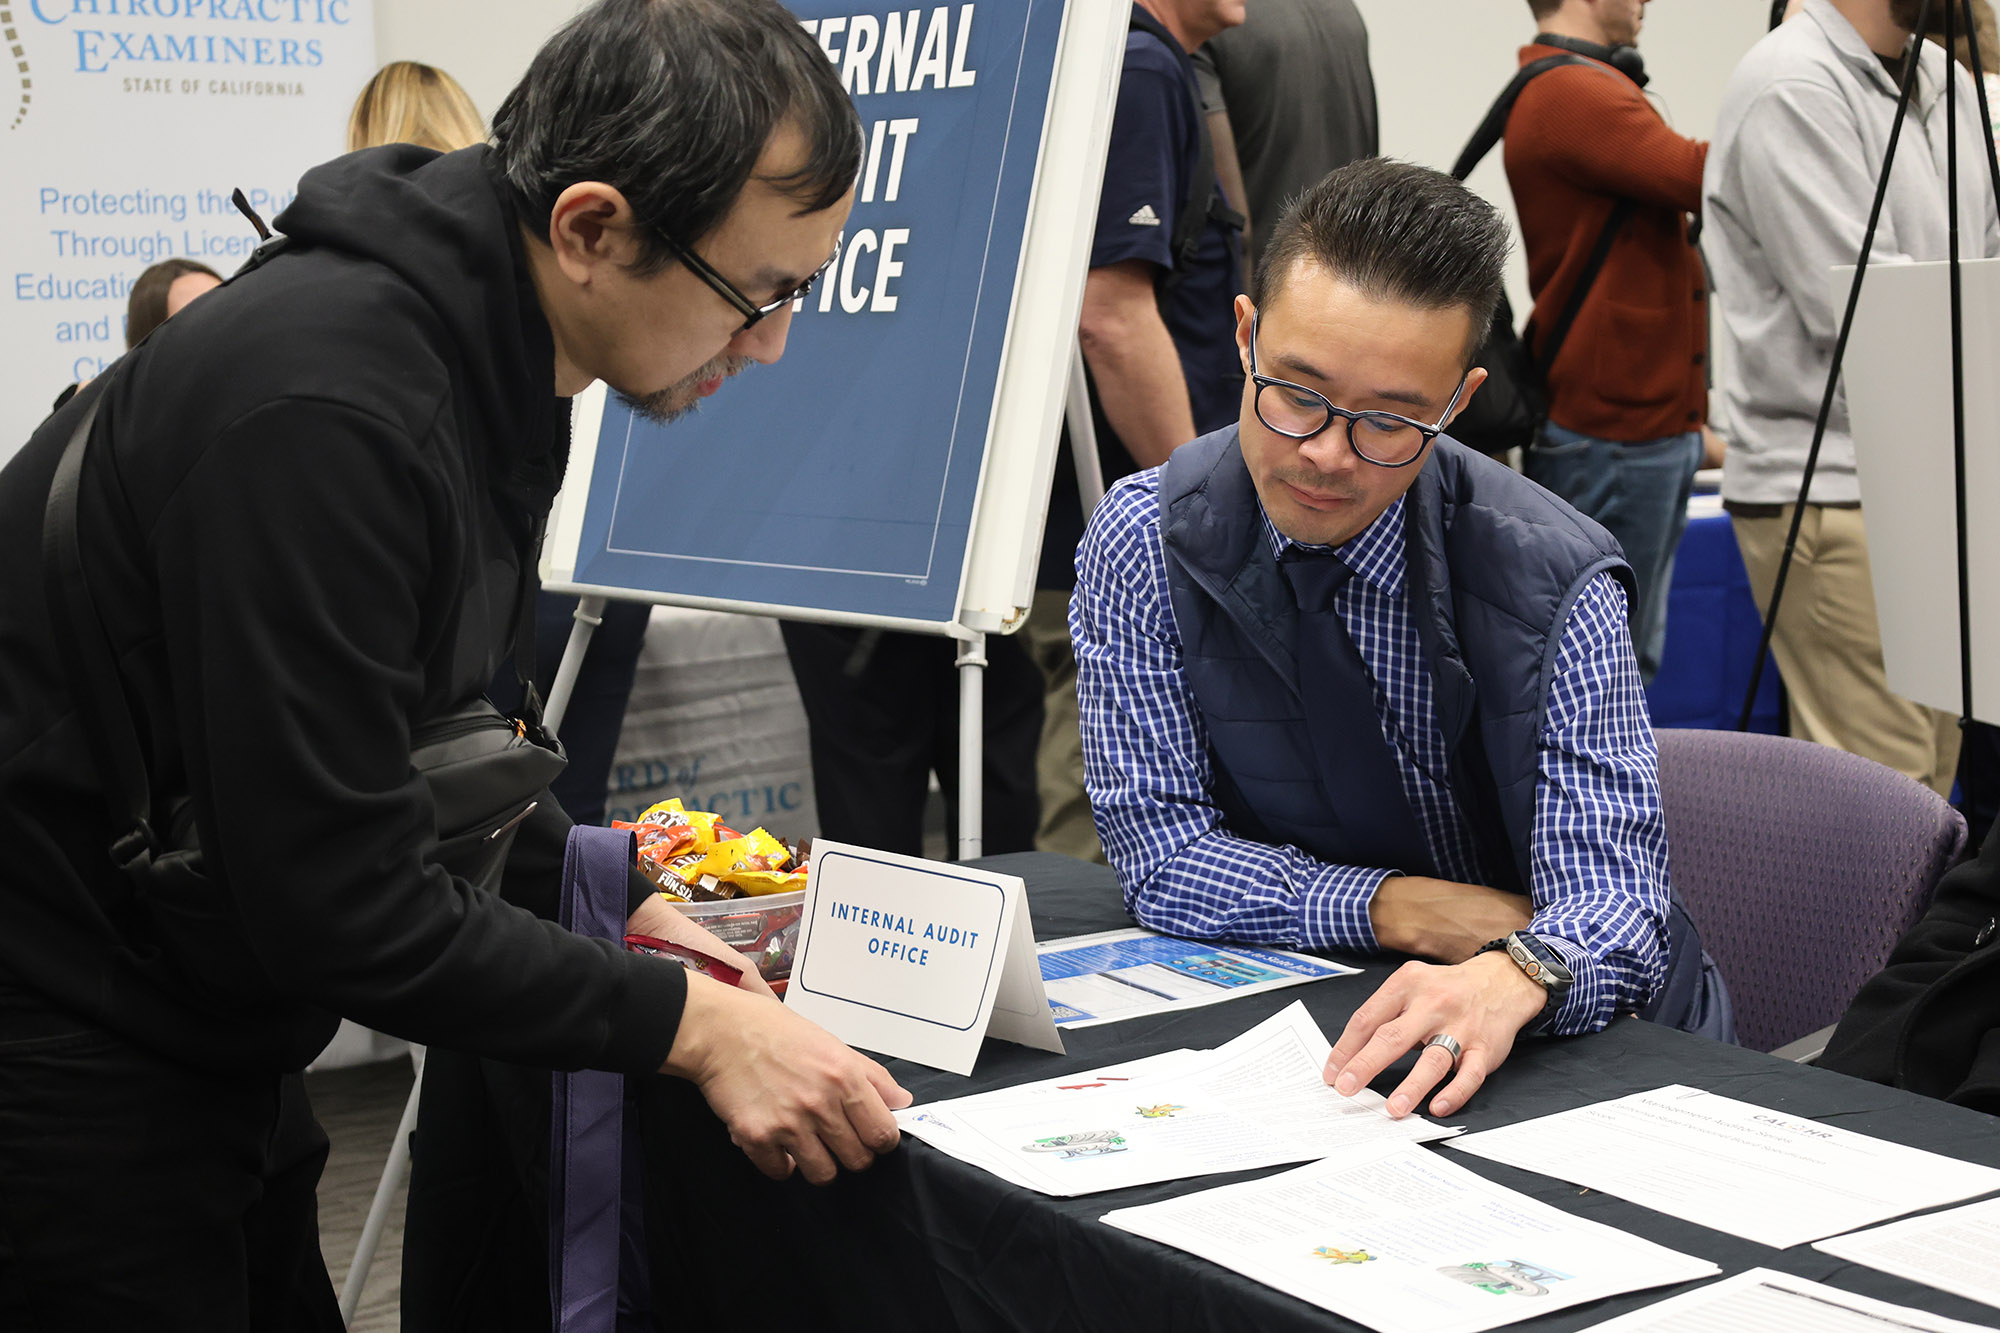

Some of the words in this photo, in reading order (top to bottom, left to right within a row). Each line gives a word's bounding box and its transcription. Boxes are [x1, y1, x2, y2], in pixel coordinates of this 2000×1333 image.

[73, 29, 324, 73] EXAMINERS
[799, 3, 977, 95] ERNAL
[123, 77, 172, 94] STATE
[181, 79, 200, 95] OF
[208, 79, 304, 96] CALIFORNIA
[853, 118, 919, 202] IT
[40, 187, 187, 220] Protecting
[198, 189, 239, 214] the
[51, 229, 174, 262] Through
[792, 228, 910, 314] ICE
[56, 315, 110, 342] and
[831, 901, 915, 935] INTERNAL
[923, 923, 979, 949] AUDIT
[868, 938, 929, 966] OFFICE
